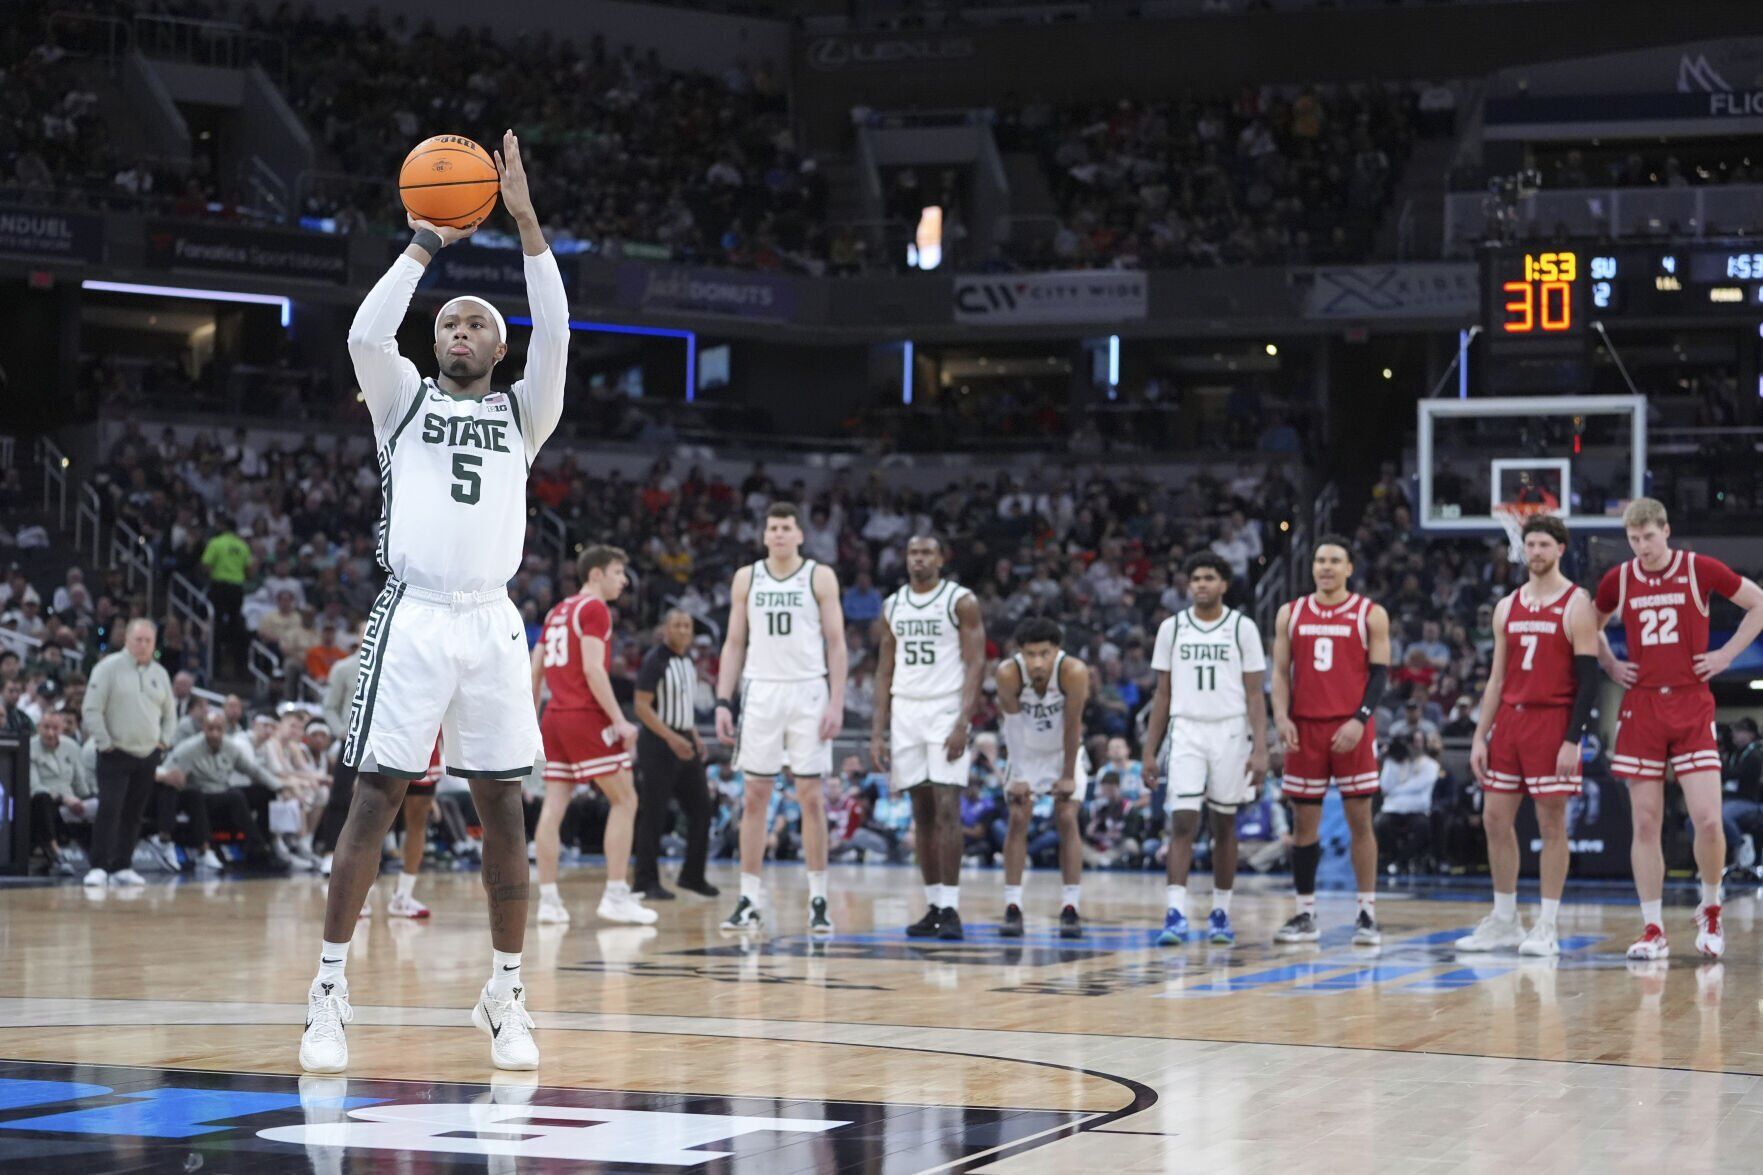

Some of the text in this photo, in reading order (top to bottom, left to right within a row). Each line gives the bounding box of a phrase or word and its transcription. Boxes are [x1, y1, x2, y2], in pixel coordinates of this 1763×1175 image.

[1524, 252, 1577, 282] 1:53
[689, 281, 773, 306] DONUTS
[1503, 280, 1570, 333] 30
[422, 412, 511, 453] STATE
[451, 452, 483, 506] 5
[755, 591, 803, 608] STATE
[765, 611, 791, 636] 10
[896, 619, 943, 637] STATE
[1639, 607, 1679, 646] 22
[904, 641, 935, 665] 55
[1180, 643, 1231, 661] STATE
[1313, 637, 1334, 672] 9
[1520, 634, 1538, 671] 7
[1194, 666, 1216, 691] 11
